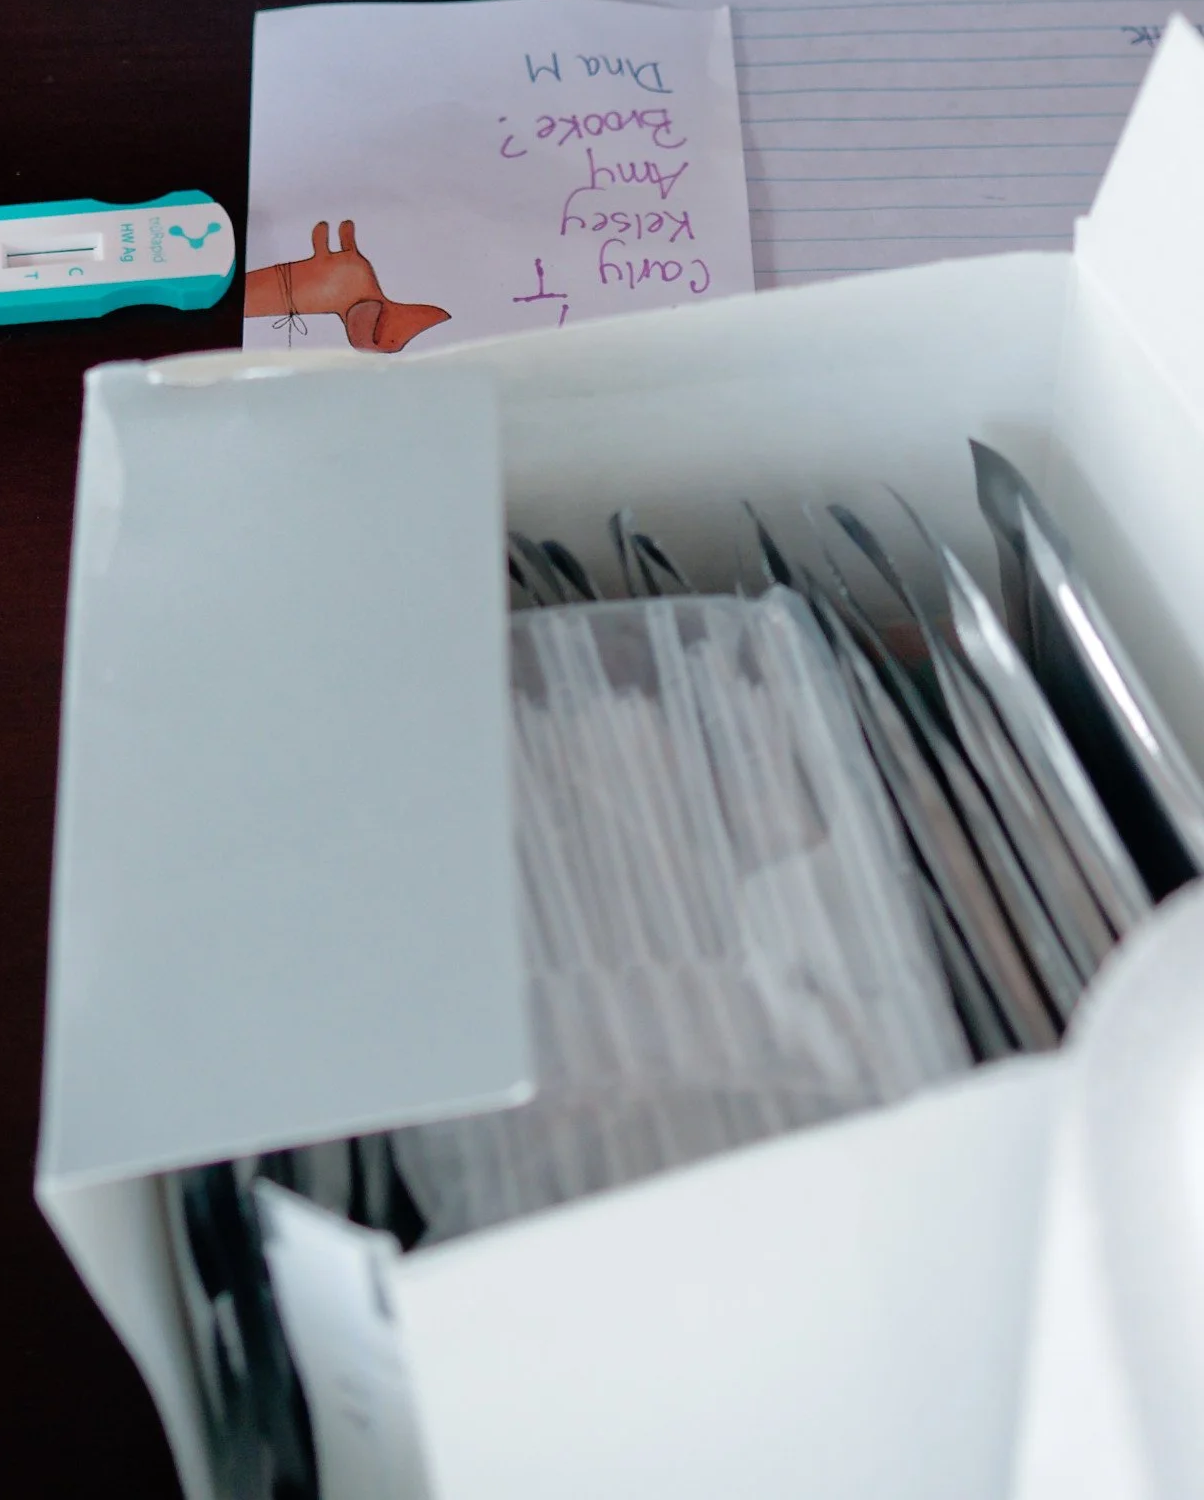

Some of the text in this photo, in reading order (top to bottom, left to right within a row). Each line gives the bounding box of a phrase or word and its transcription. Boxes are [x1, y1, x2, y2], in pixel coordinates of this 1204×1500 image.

[524, 51, 562, 83] M
[586, 148, 689, 200] Amy
[559, 187, 696, 243] Kelsey
[119, 223, 137, 263] HW Ag
[24, 271, 39, 280] T
[68, 266, 84, 277] C
[598, 237, 711, 294] Carly
